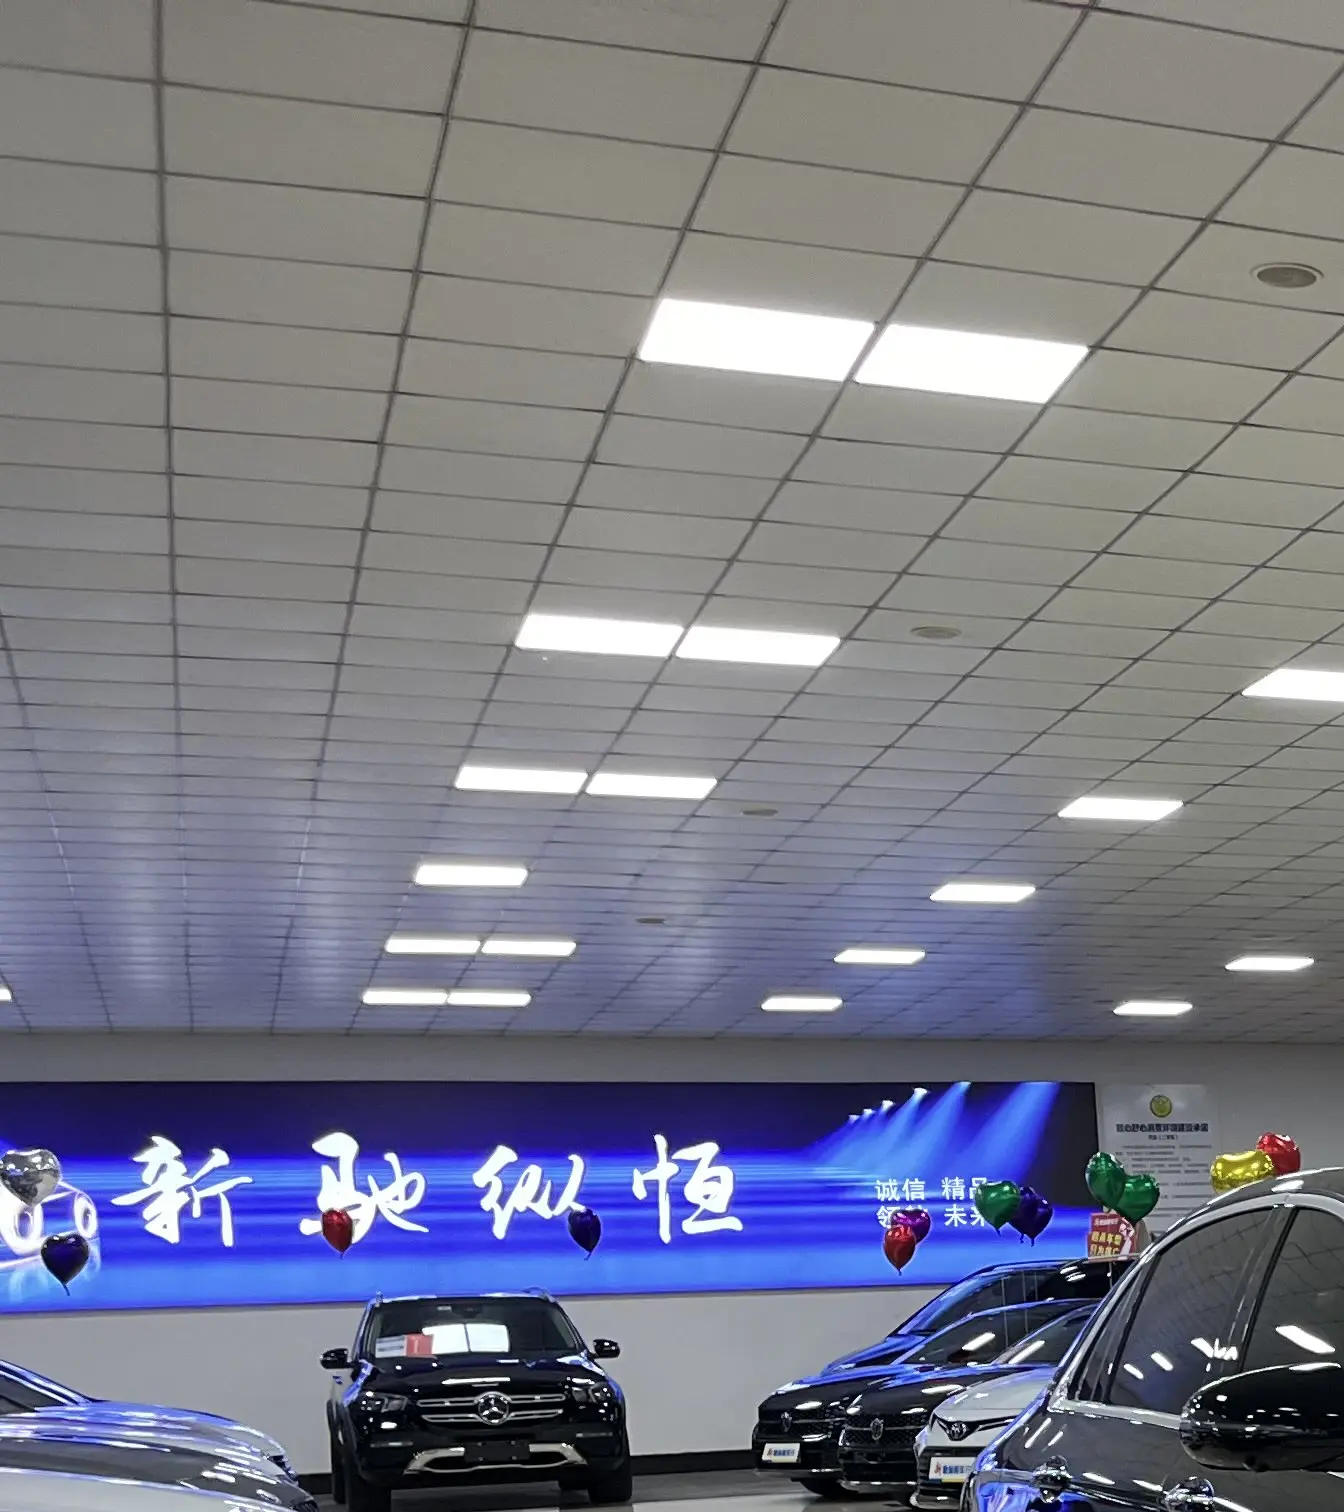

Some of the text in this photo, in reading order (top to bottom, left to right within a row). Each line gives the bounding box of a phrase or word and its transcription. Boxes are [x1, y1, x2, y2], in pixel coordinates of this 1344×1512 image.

[111, 1132, 743, 1247] 新驰纵恒
[875, 1178, 925, 1201] 诚信
[876, 1204, 928, 1229] 领
